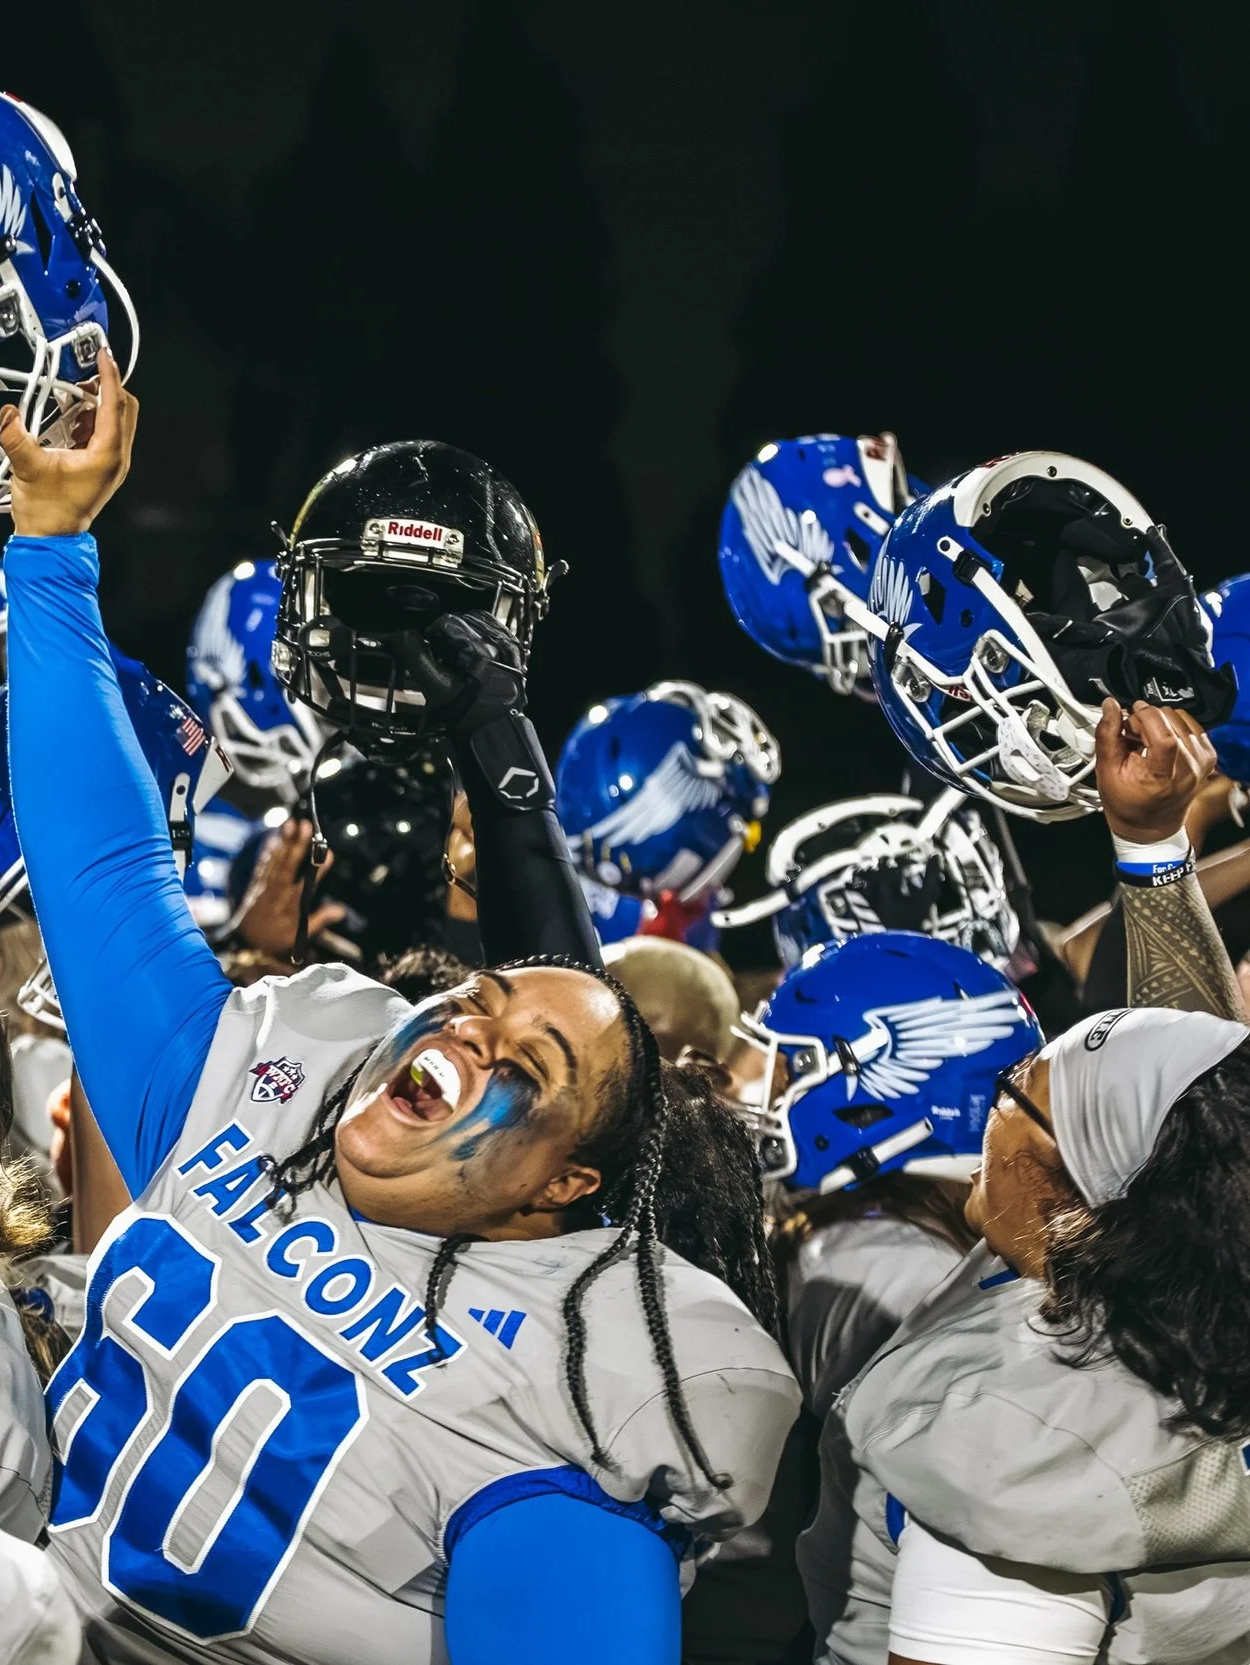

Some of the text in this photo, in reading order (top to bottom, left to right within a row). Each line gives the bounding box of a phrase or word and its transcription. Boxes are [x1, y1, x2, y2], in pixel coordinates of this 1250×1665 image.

[387, 521, 443, 542] Riddell
[1152, 867, 1184, 886] KEEP
[173, 1118, 468, 1402] FALCONZ
[43, 1212, 370, 1645] 60
